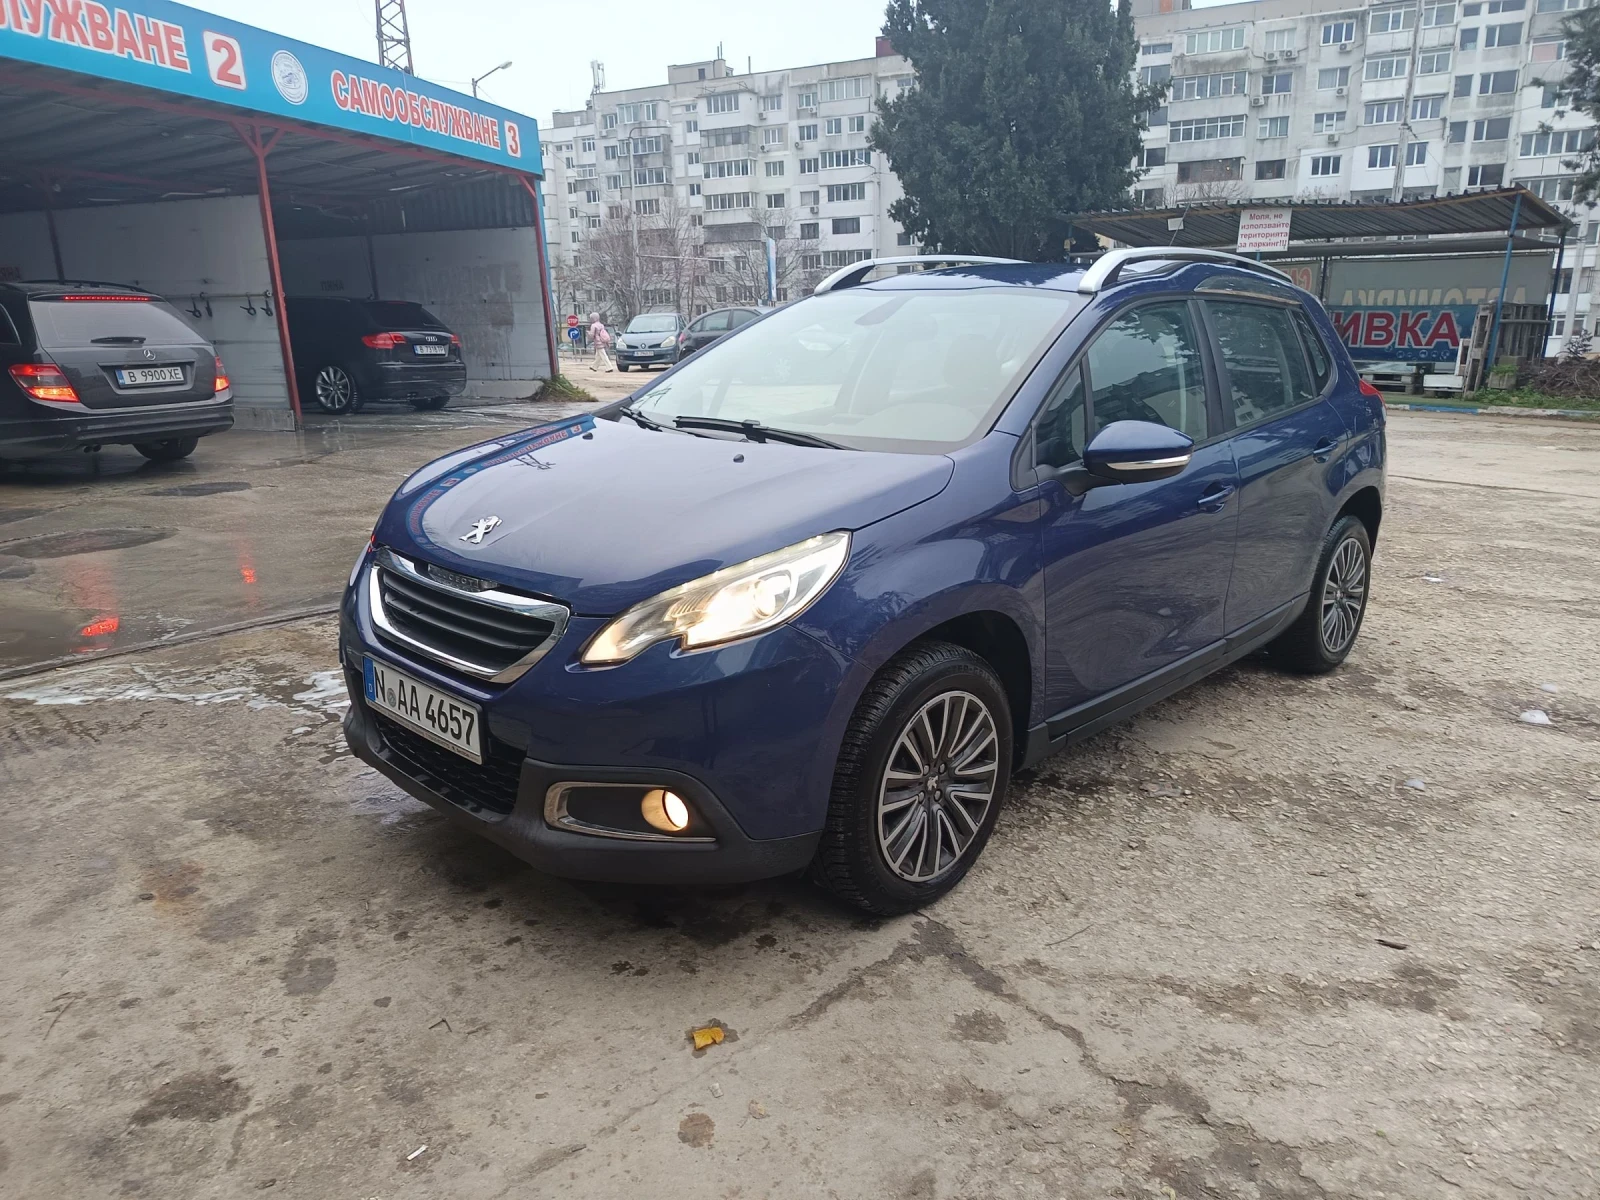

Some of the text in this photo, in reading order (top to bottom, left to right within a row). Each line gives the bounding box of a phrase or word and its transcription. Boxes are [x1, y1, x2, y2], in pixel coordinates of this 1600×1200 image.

[210, 37, 243, 86] 2
[332, 70, 500, 149] САМООБСЛУЖВАНЕ
[507, 124, 520, 156] 3
[1241, 221, 1290, 230] използвайте
[1240, 231, 1288, 240] територията
[141, 369, 167, 382] 9900
[369, 683, 373, 693] D
[374, 666, 386, 702] N
[398, 679, 421, 721] AA
[425, 694, 475, 746] 4657
